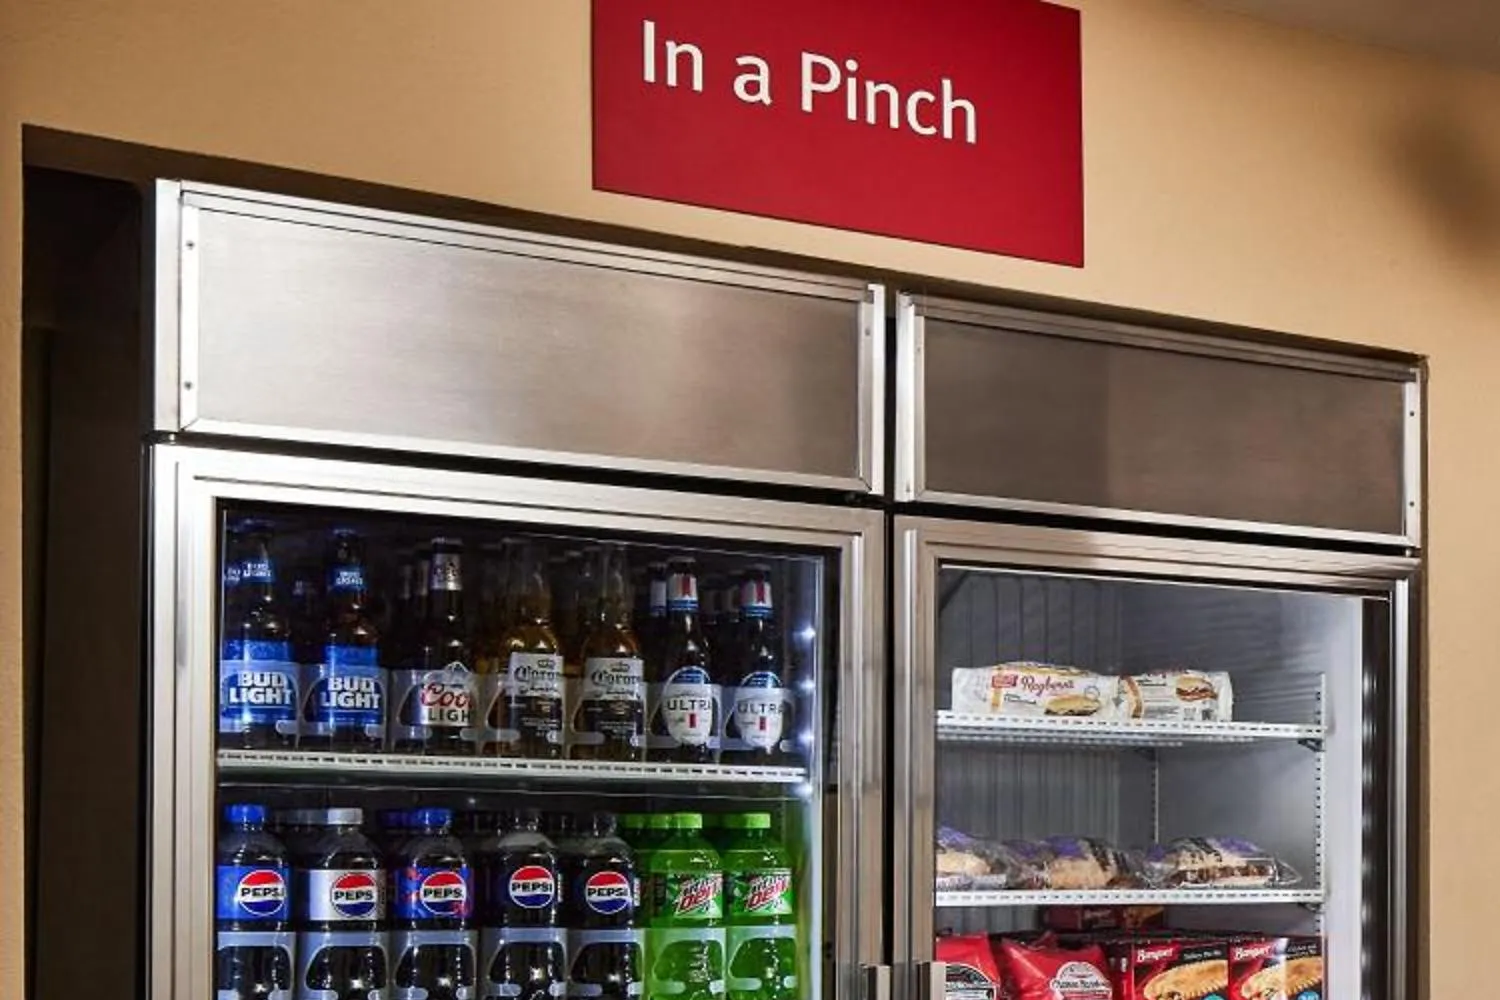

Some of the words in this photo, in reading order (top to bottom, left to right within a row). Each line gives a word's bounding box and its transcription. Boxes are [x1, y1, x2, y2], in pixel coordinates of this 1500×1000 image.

[642, 19, 703, 92] In
[733, 55, 772, 105] a
[801, 51, 976, 145] Pinch
[237, 671, 288, 688] BUD
[327, 675, 375, 692] BUD
[229, 687, 292, 705] LIGHT
[320, 690, 381, 709] LIGHT
[428, 708, 471, 722] LIGH
[511, 882, 553, 892] PEPSI
[587, 887, 629, 898] PEPSI
